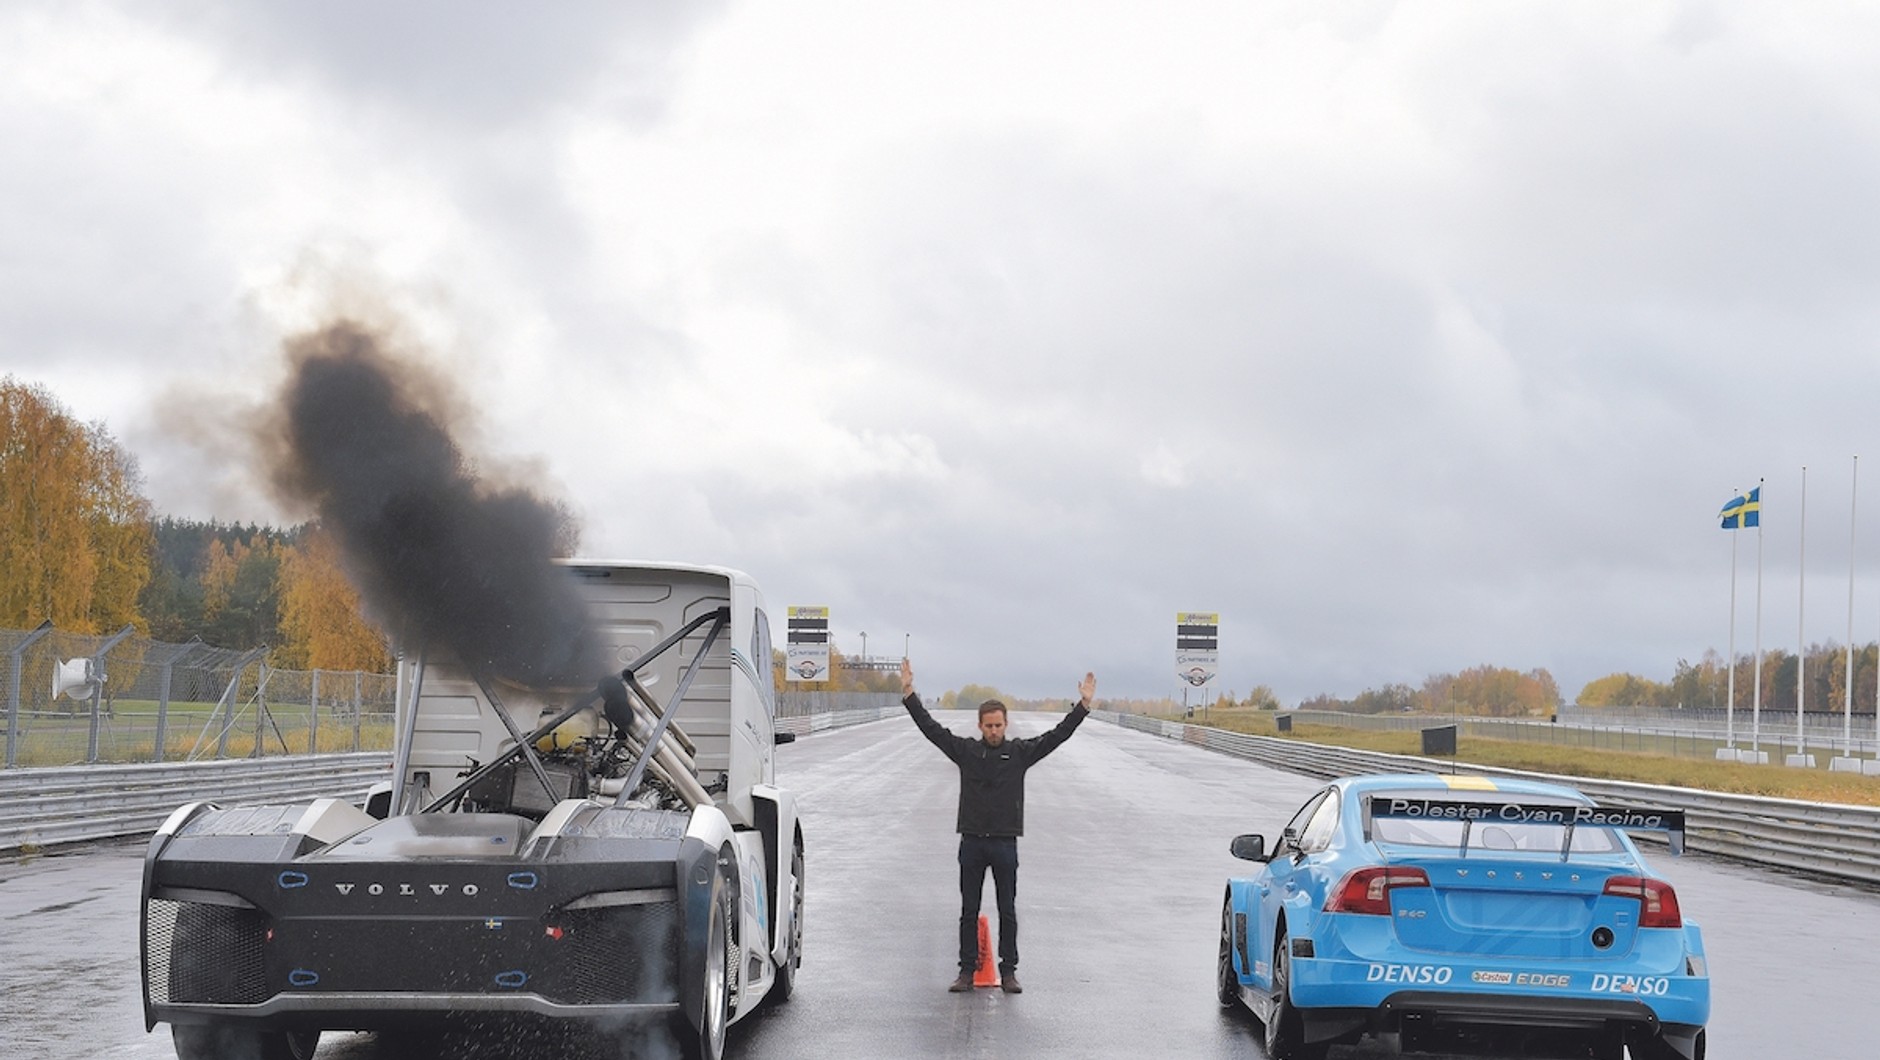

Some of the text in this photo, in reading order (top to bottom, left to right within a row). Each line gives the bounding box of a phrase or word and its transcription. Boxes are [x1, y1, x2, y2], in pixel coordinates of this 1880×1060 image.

[1388, 800, 1663, 829] Polestar Cyan Racing
[335, 883, 480, 896] VOLVO
[1366, 964, 1453, 985] DENSO
[1481, 973, 1571, 987] Castrol EDGE
[1591, 974, 1669, 996] DENSO
